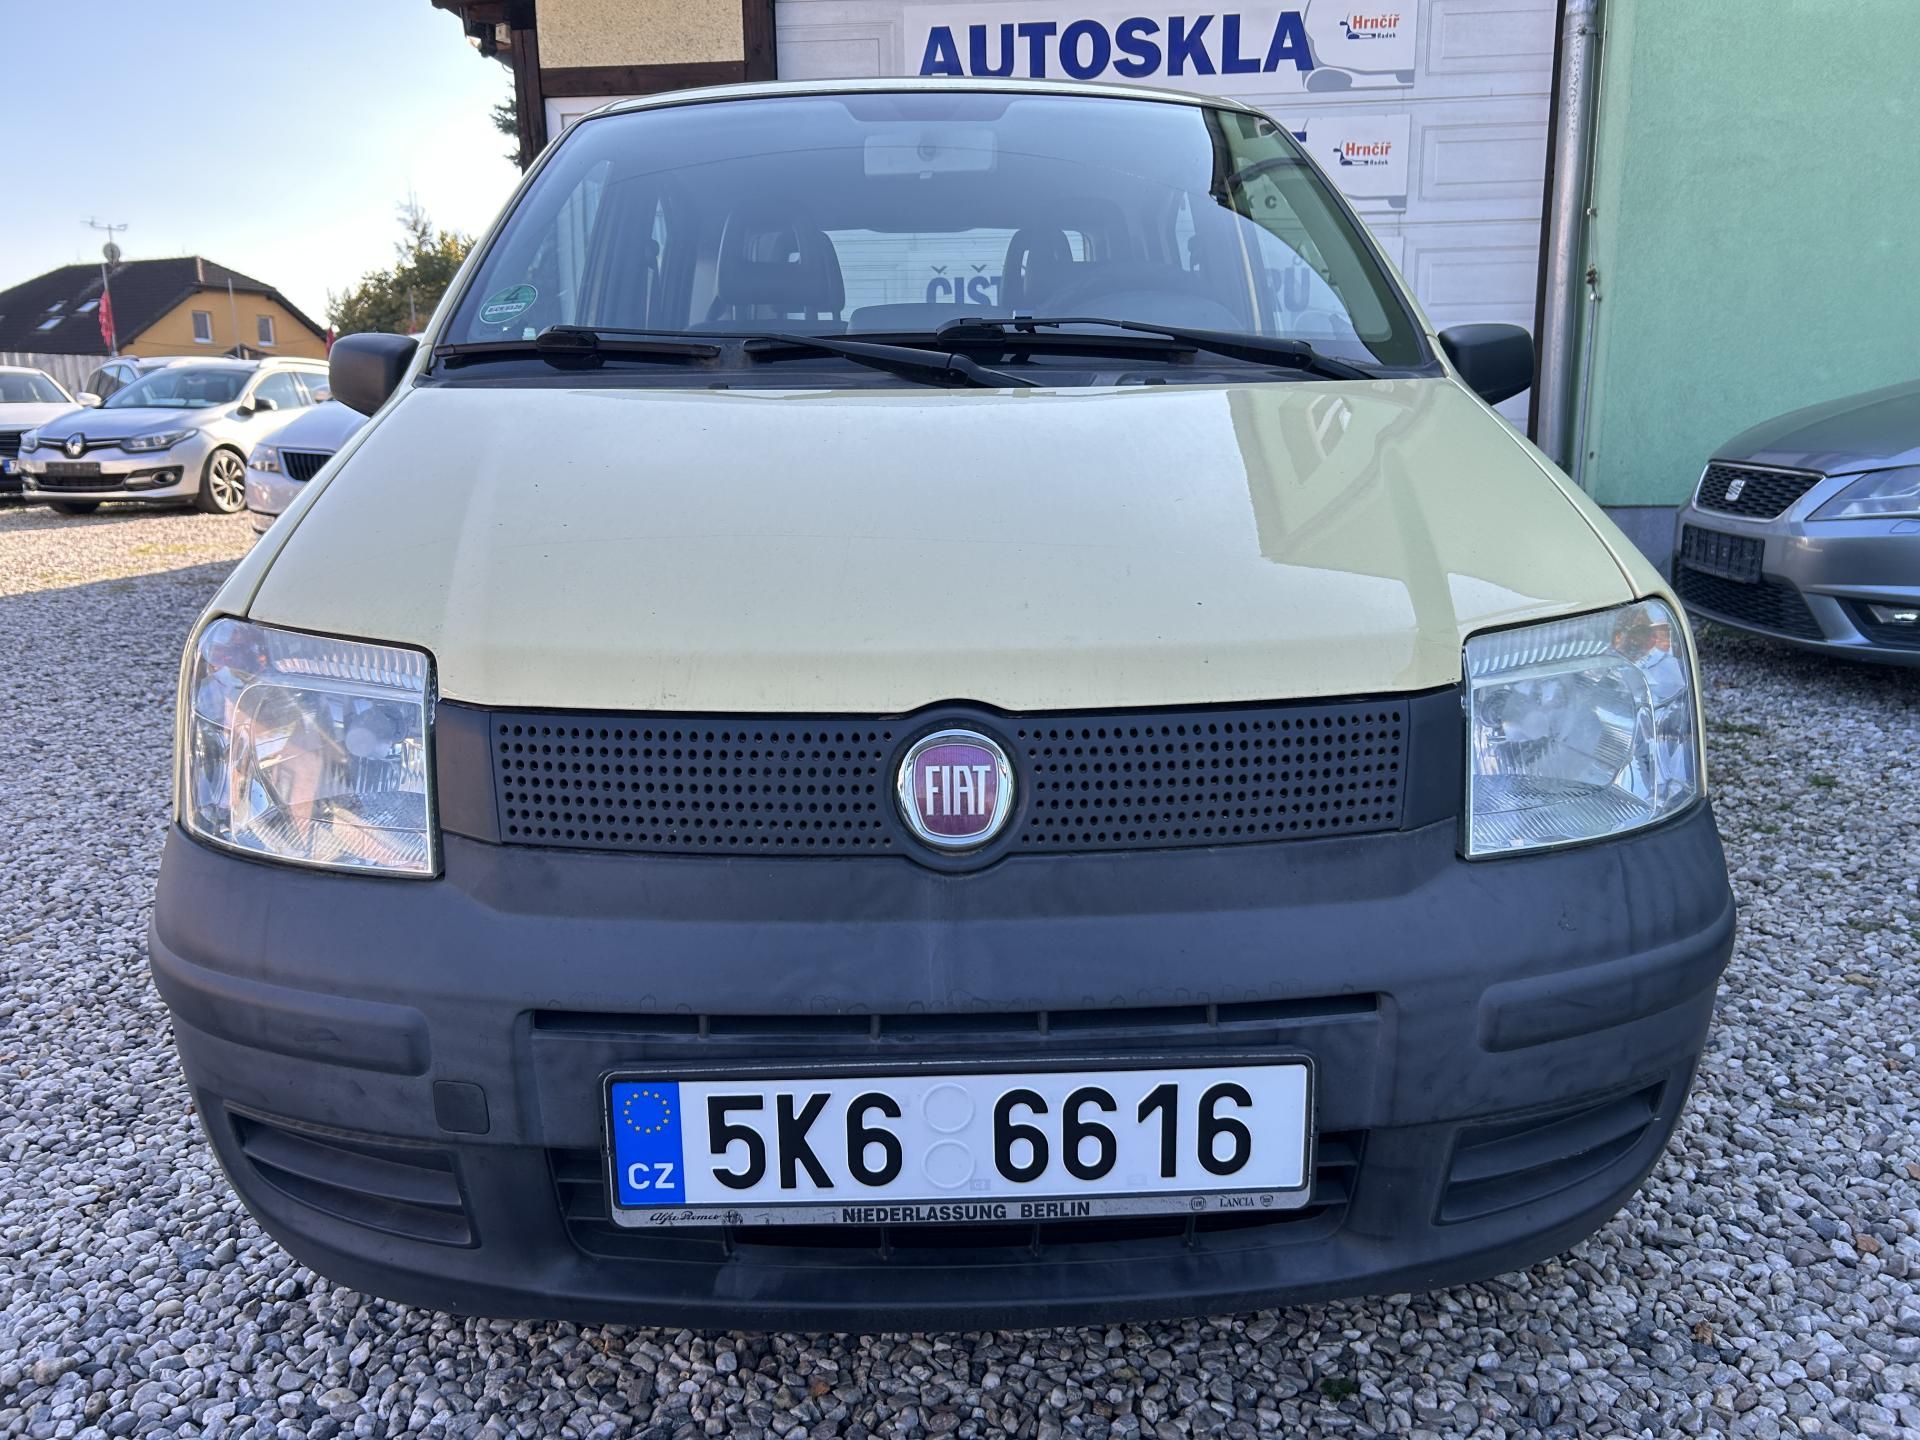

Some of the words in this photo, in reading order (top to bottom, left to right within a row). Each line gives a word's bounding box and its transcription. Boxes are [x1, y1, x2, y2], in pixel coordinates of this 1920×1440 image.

[1352, 13, 1400, 29] Hrnčíř
[919, 11, 1315, 80] AUTOSKLA
[1345, 141, 1391, 156] Hrnčíř
[925, 765, 991, 816] FIAT
[707, 1092, 903, 1190] 5K6
[993, 1082, 1253, 1183] 6616
[628, 1163, 675, 1189] CZ
[842, 1203, 1007, 1223] NIEDERLASSUNG
[1020, 1201, 1090, 1218] BERLIN
[1219, 1196, 1255, 1208] LANCIA
